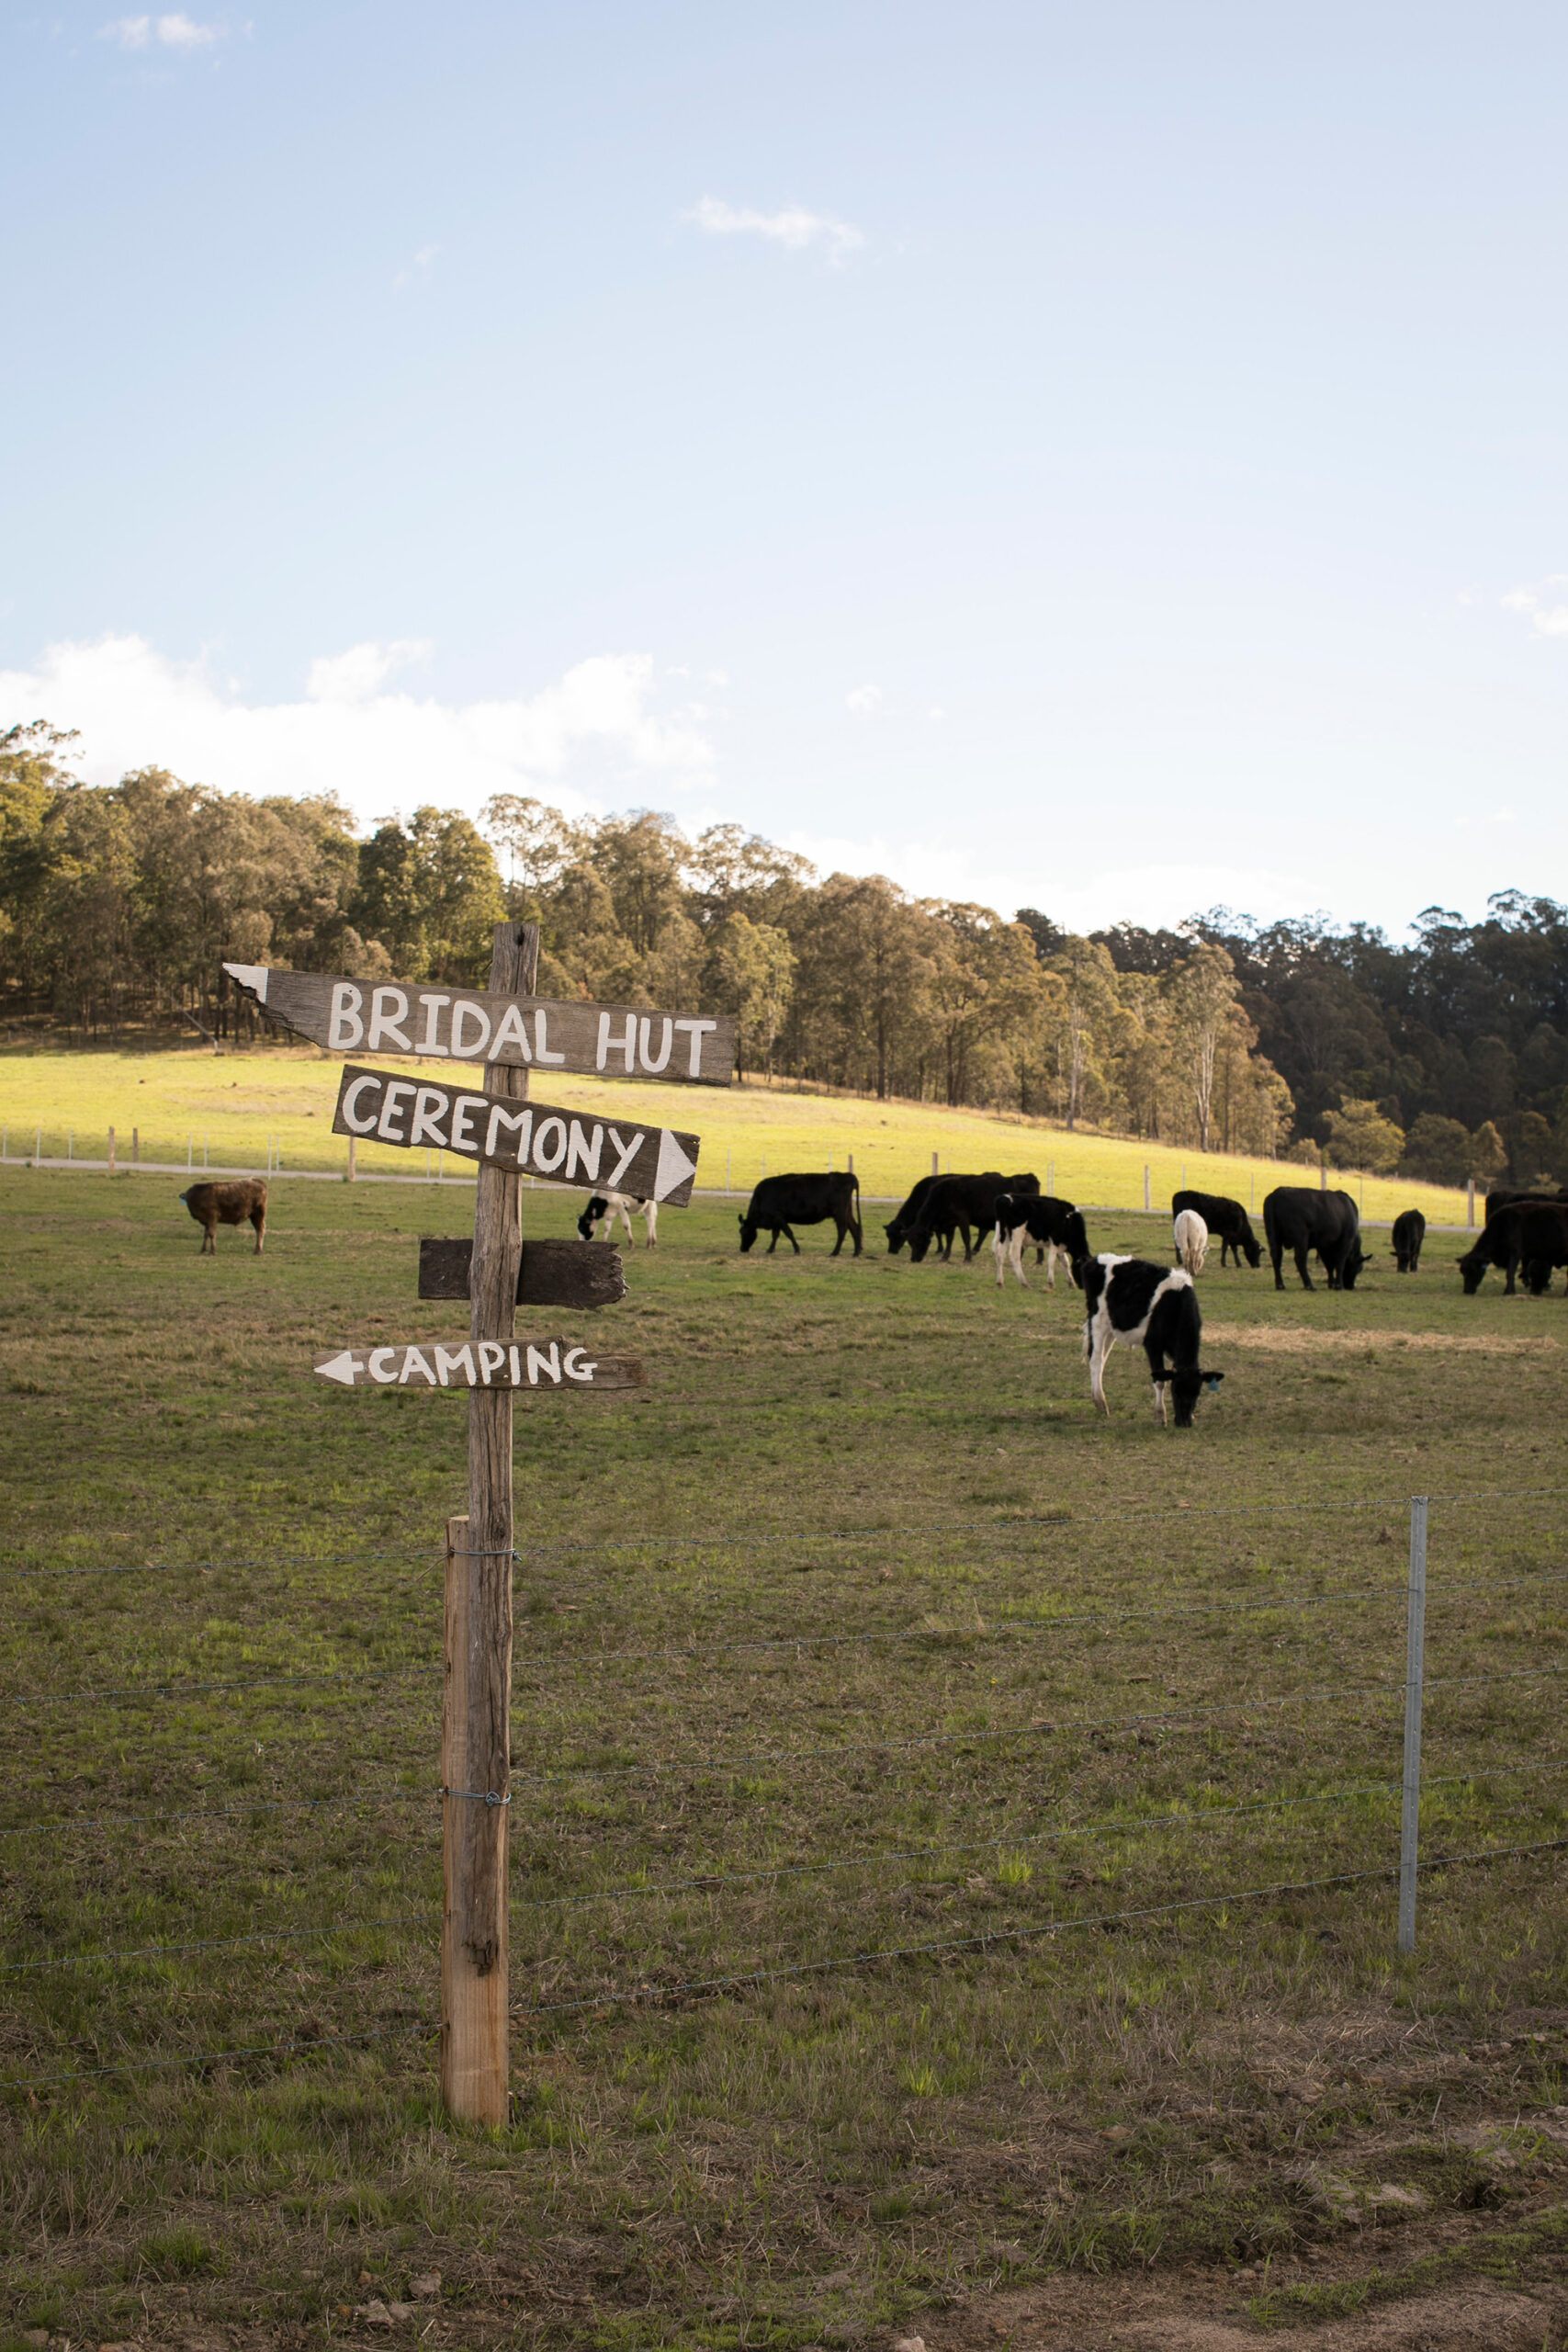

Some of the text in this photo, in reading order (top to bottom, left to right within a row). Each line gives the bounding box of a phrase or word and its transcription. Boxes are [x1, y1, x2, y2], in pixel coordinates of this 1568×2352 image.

[328, 983, 717, 1078] BRIDAL HUT
[342, 1075, 646, 1188] CEREMONY
[367, 1341, 598, 1386] CAMPING
